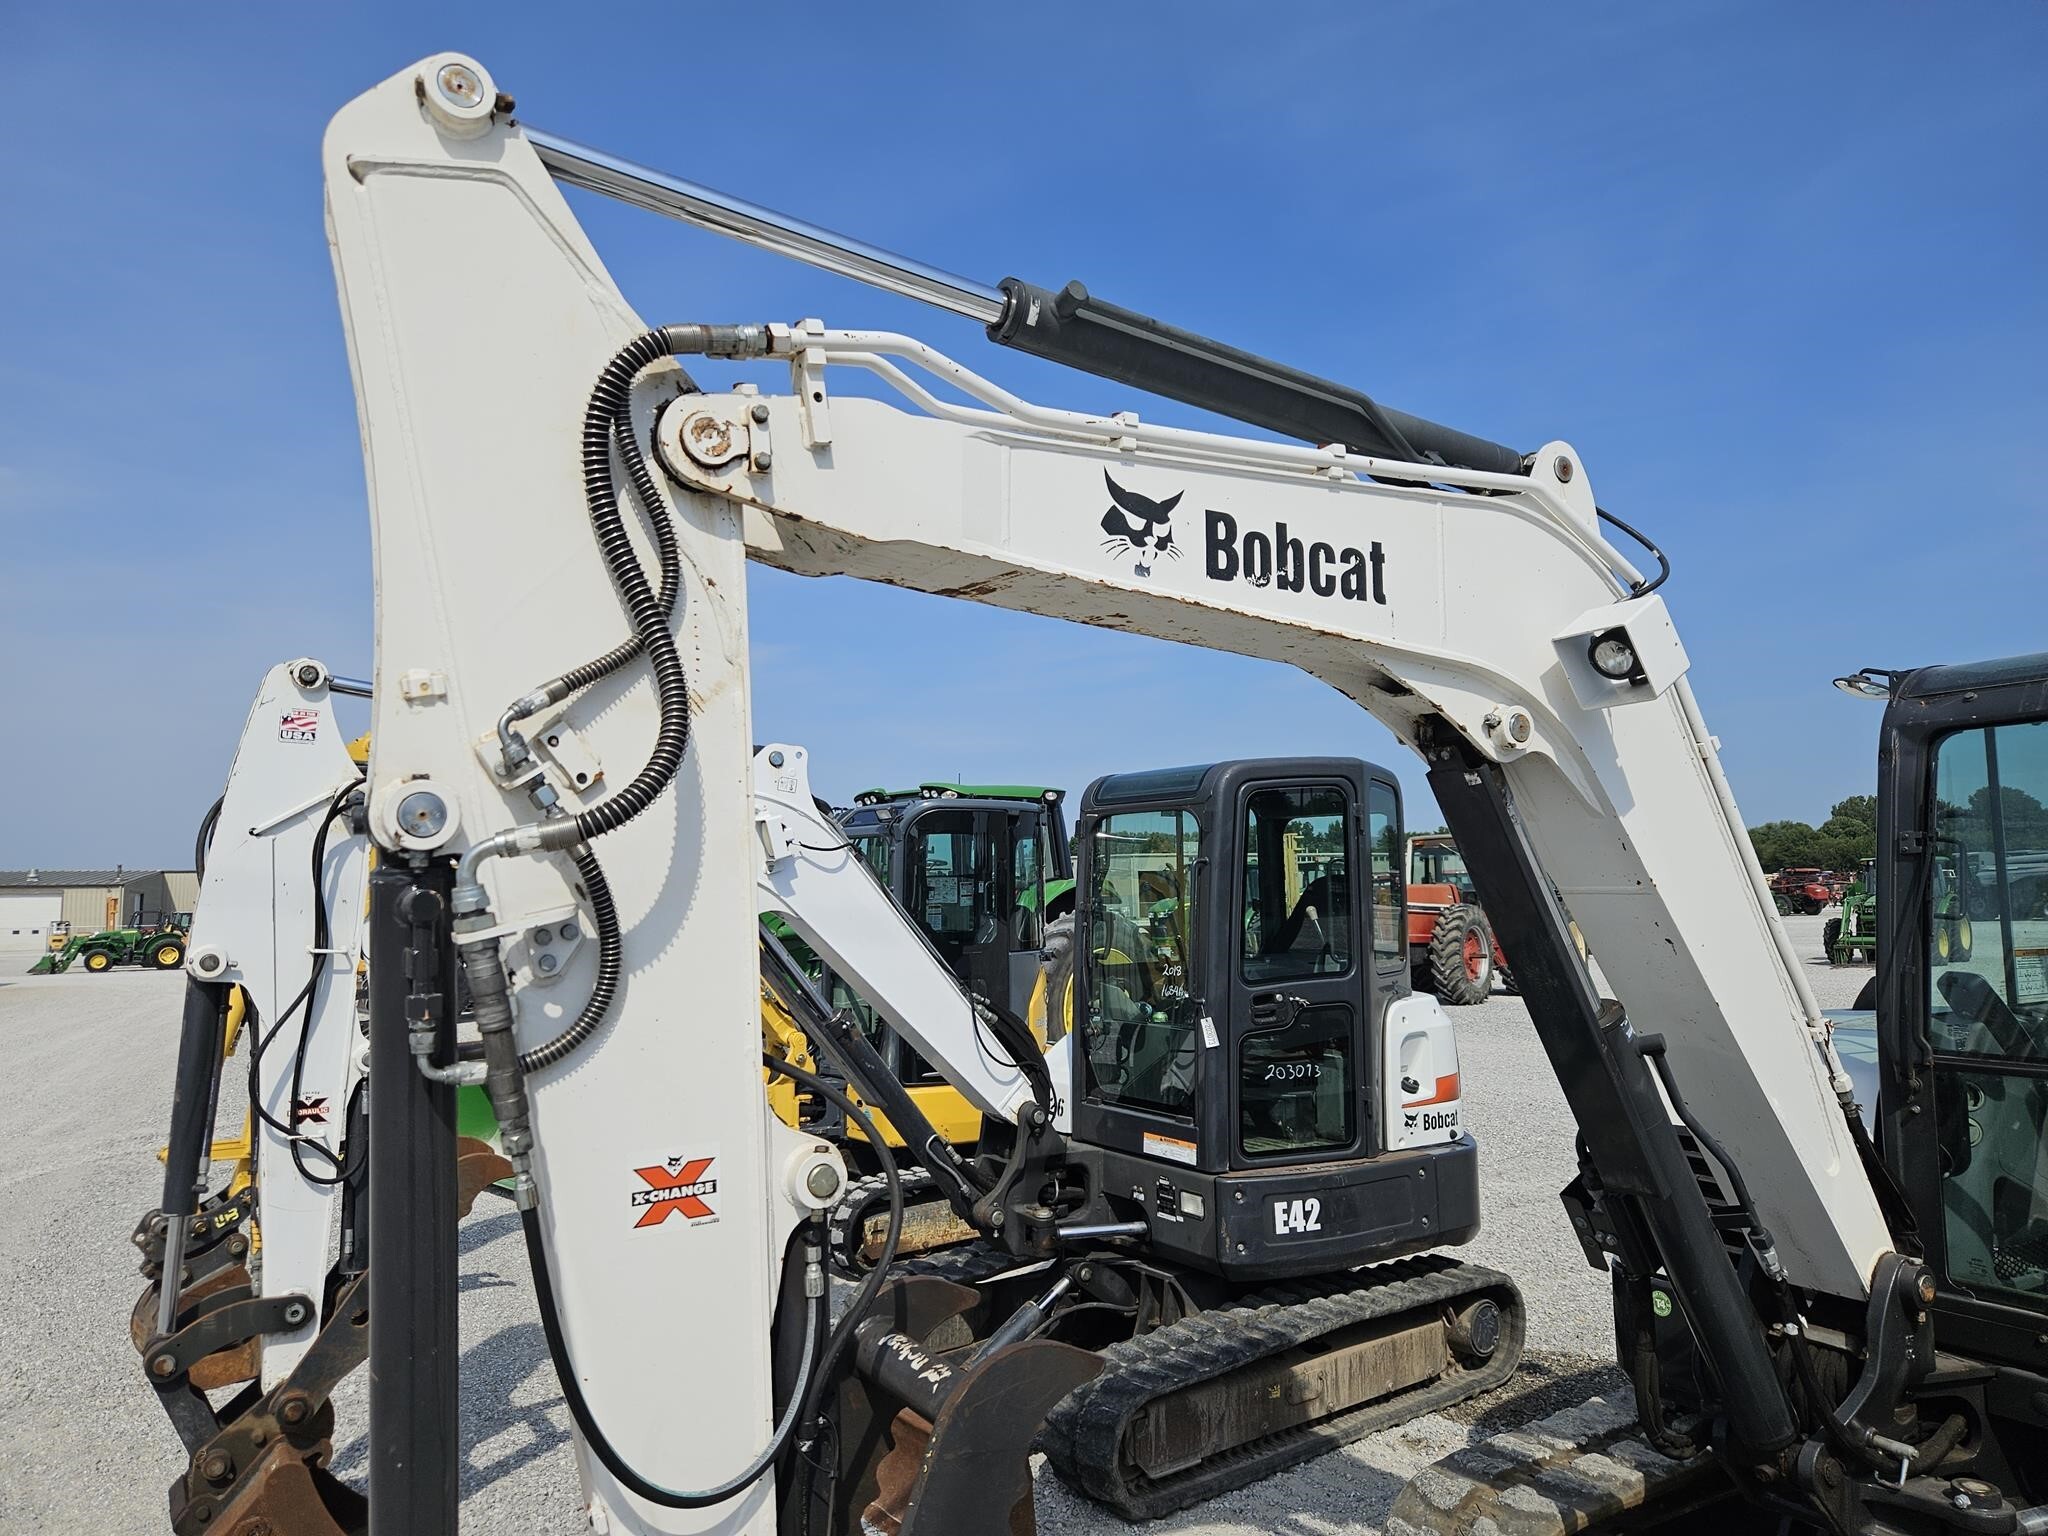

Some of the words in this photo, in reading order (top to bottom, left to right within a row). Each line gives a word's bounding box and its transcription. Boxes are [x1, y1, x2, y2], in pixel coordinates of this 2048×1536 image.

[1205, 509, 1387, 606] Bobcat
[281, 730, 316, 741] USA
[1162, 963, 1182, 977] 2018
[1423, 1109, 1459, 1131] Bobcat
[633, 1181, 715, 1205] X-CHANGE
[1274, 1198, 1321, 1235] E42
